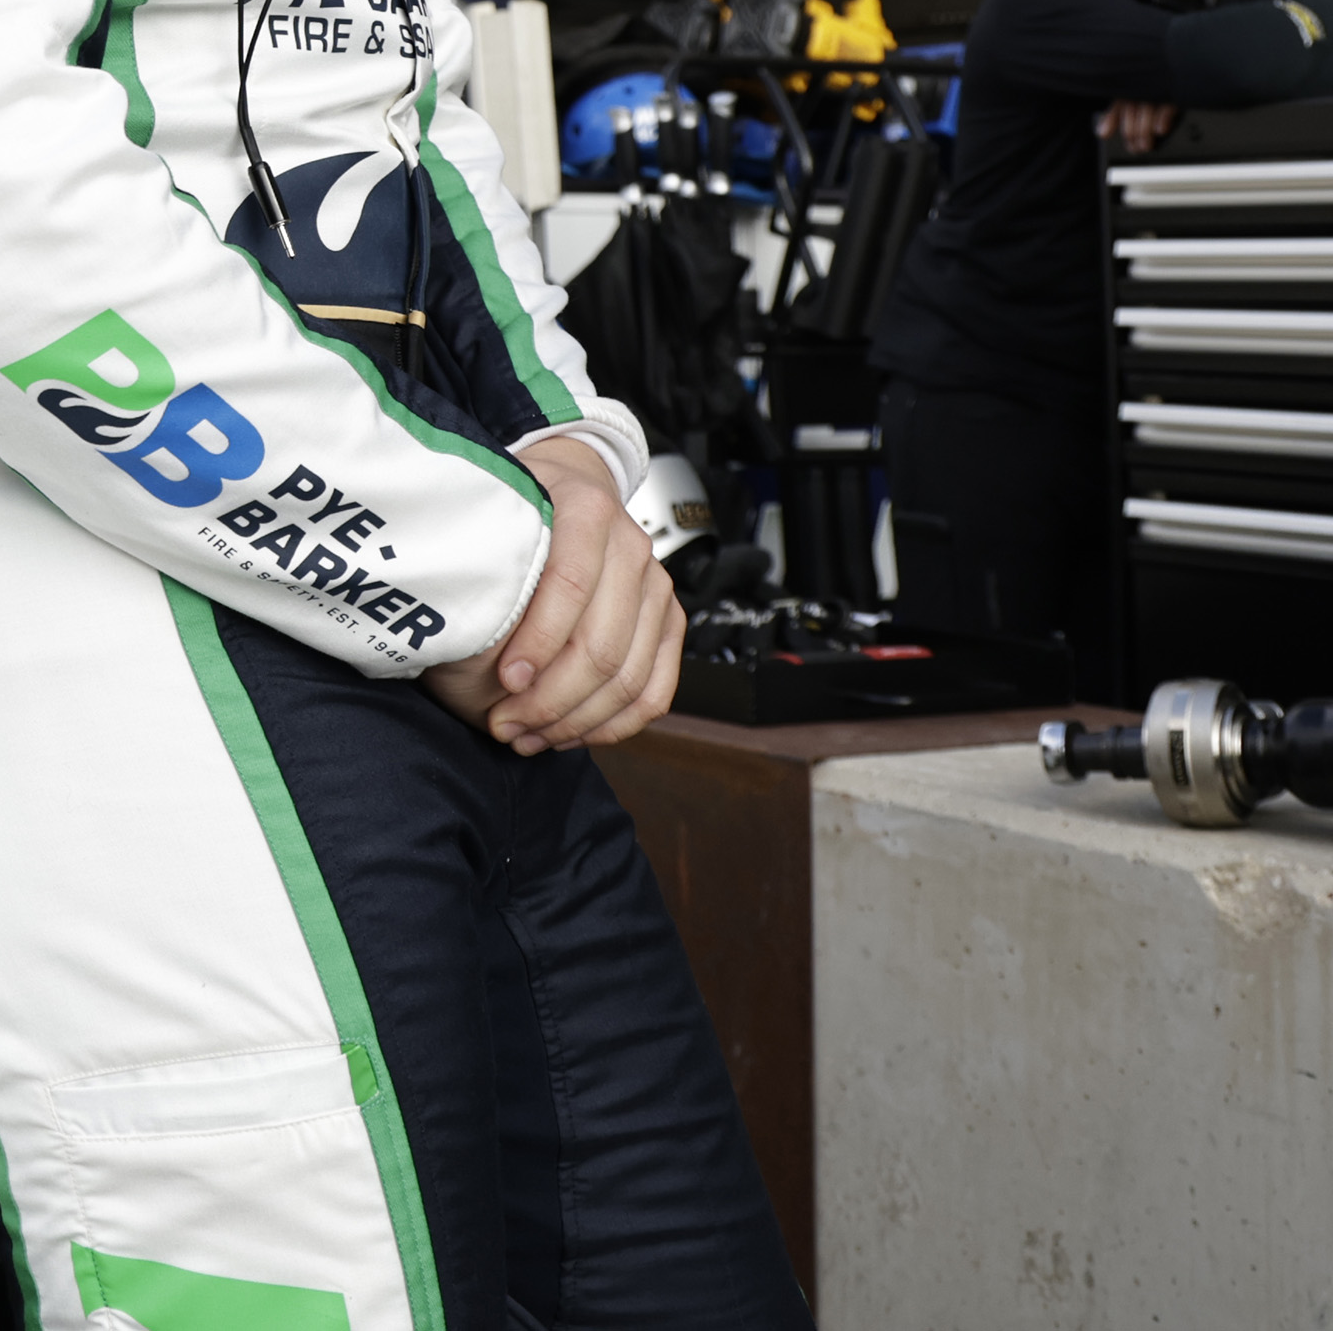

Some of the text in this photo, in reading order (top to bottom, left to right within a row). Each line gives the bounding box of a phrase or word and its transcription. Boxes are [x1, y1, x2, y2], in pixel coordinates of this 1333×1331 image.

[268, 15, 353, 54] FIRE
[364, 20, 385, 55] &
[267, 463, 388, 553] PYE
[197, 526, 236, 560] FIRE
[366, 634, 410, 664] 1946
[217, 500, 447, 651] BARKER
